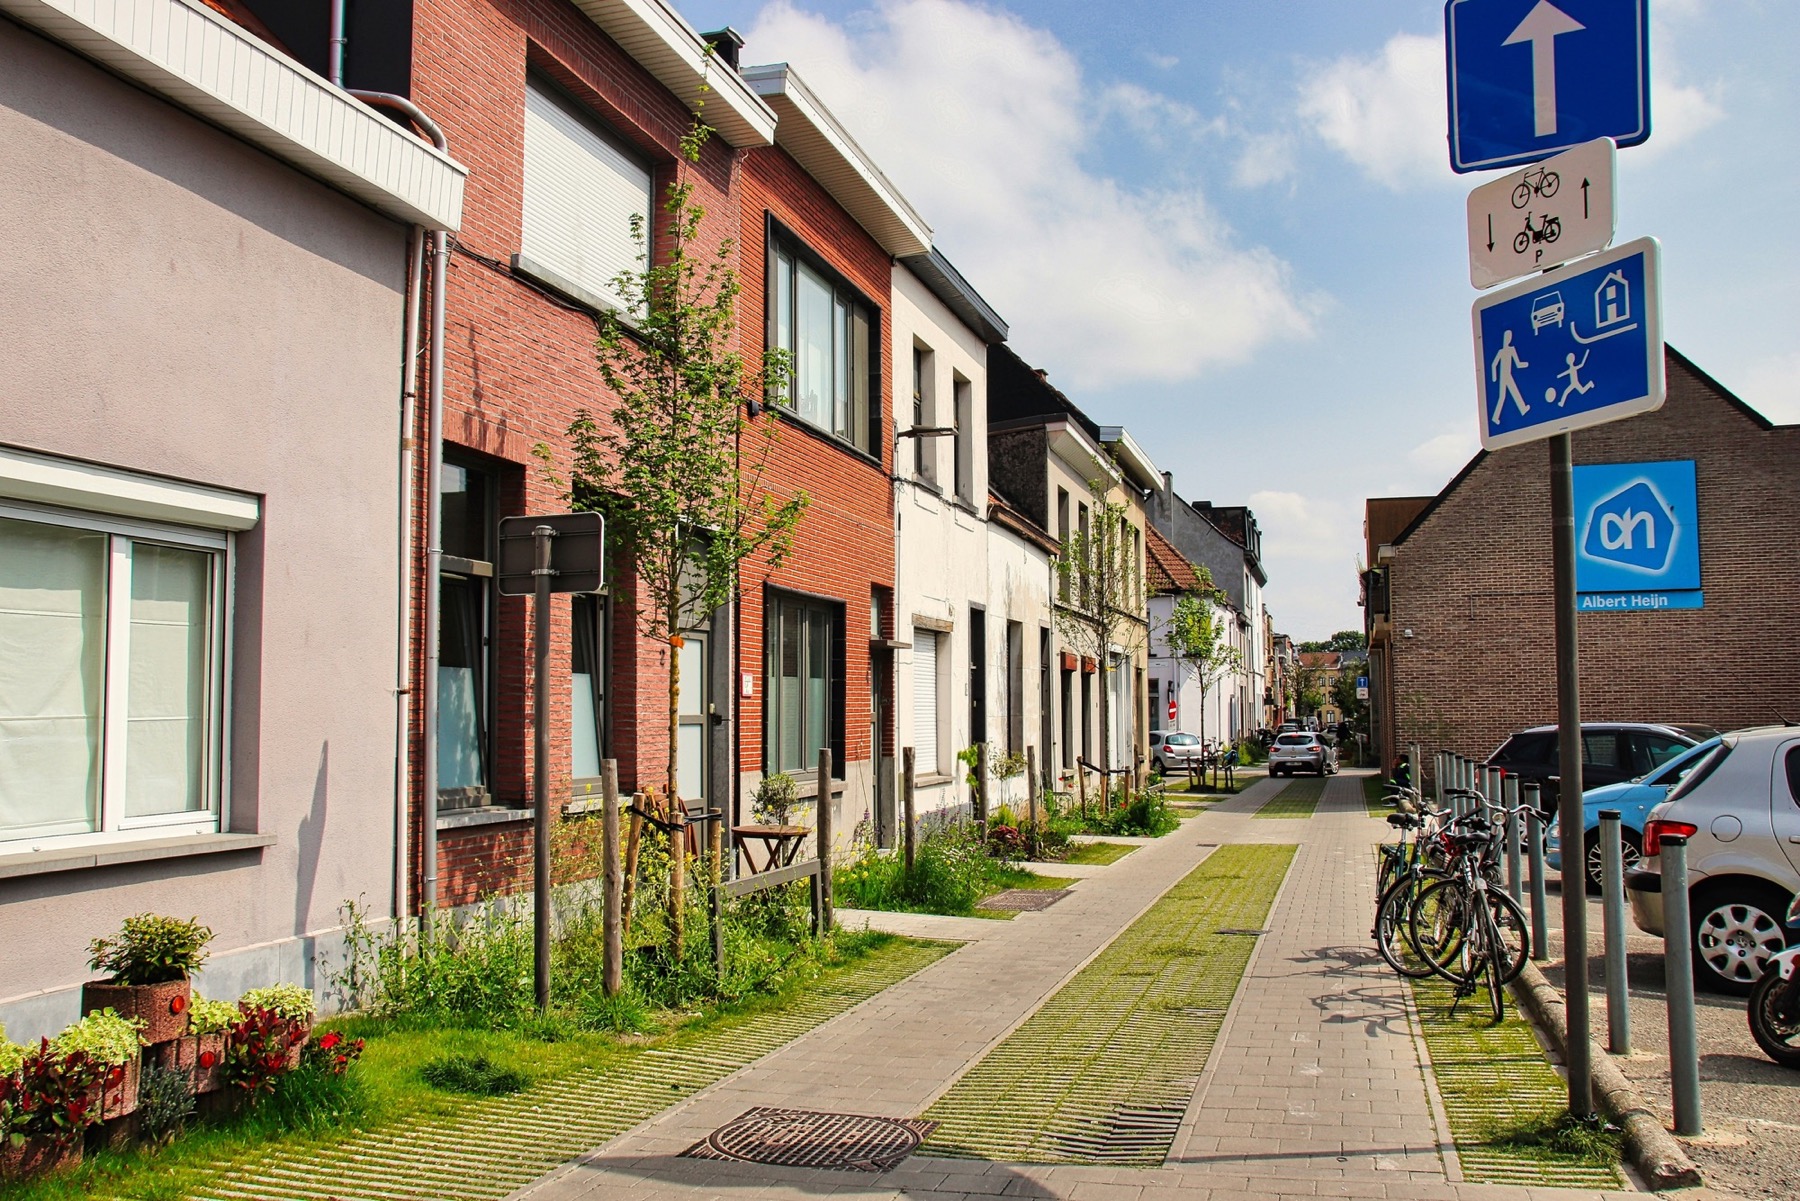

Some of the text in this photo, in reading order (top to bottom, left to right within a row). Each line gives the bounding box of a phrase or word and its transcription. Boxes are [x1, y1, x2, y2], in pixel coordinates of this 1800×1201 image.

[1535, 249, 1543, 263] P
[1582, 593, 1668, 609] Albert Heijn
